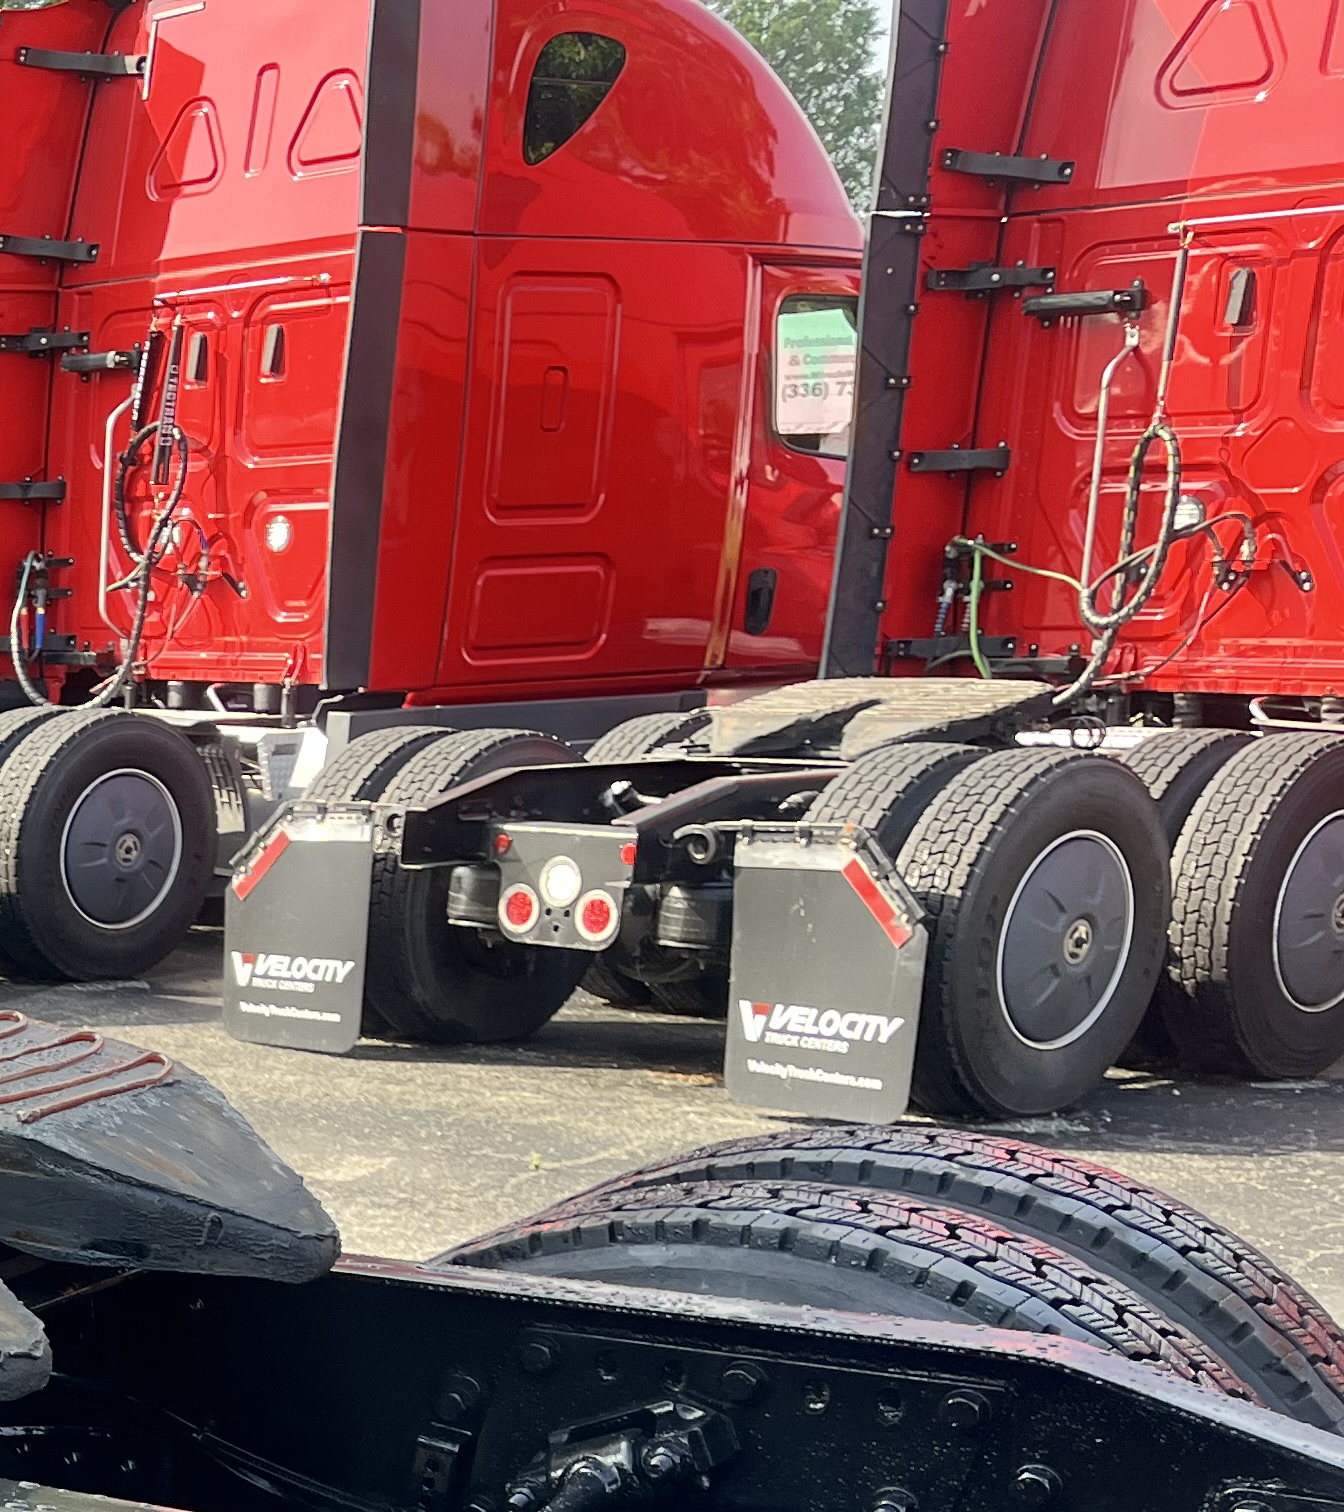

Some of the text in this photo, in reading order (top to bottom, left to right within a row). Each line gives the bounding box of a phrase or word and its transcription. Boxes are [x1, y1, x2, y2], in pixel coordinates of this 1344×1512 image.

[781, 382, 829, 403] (336)
[254, 953, 355, 983] VELOCITY
[769, 1003, 905, 1044] VELOCITY
[765, 1031, 850, 1053] TRUCK CENTERS
